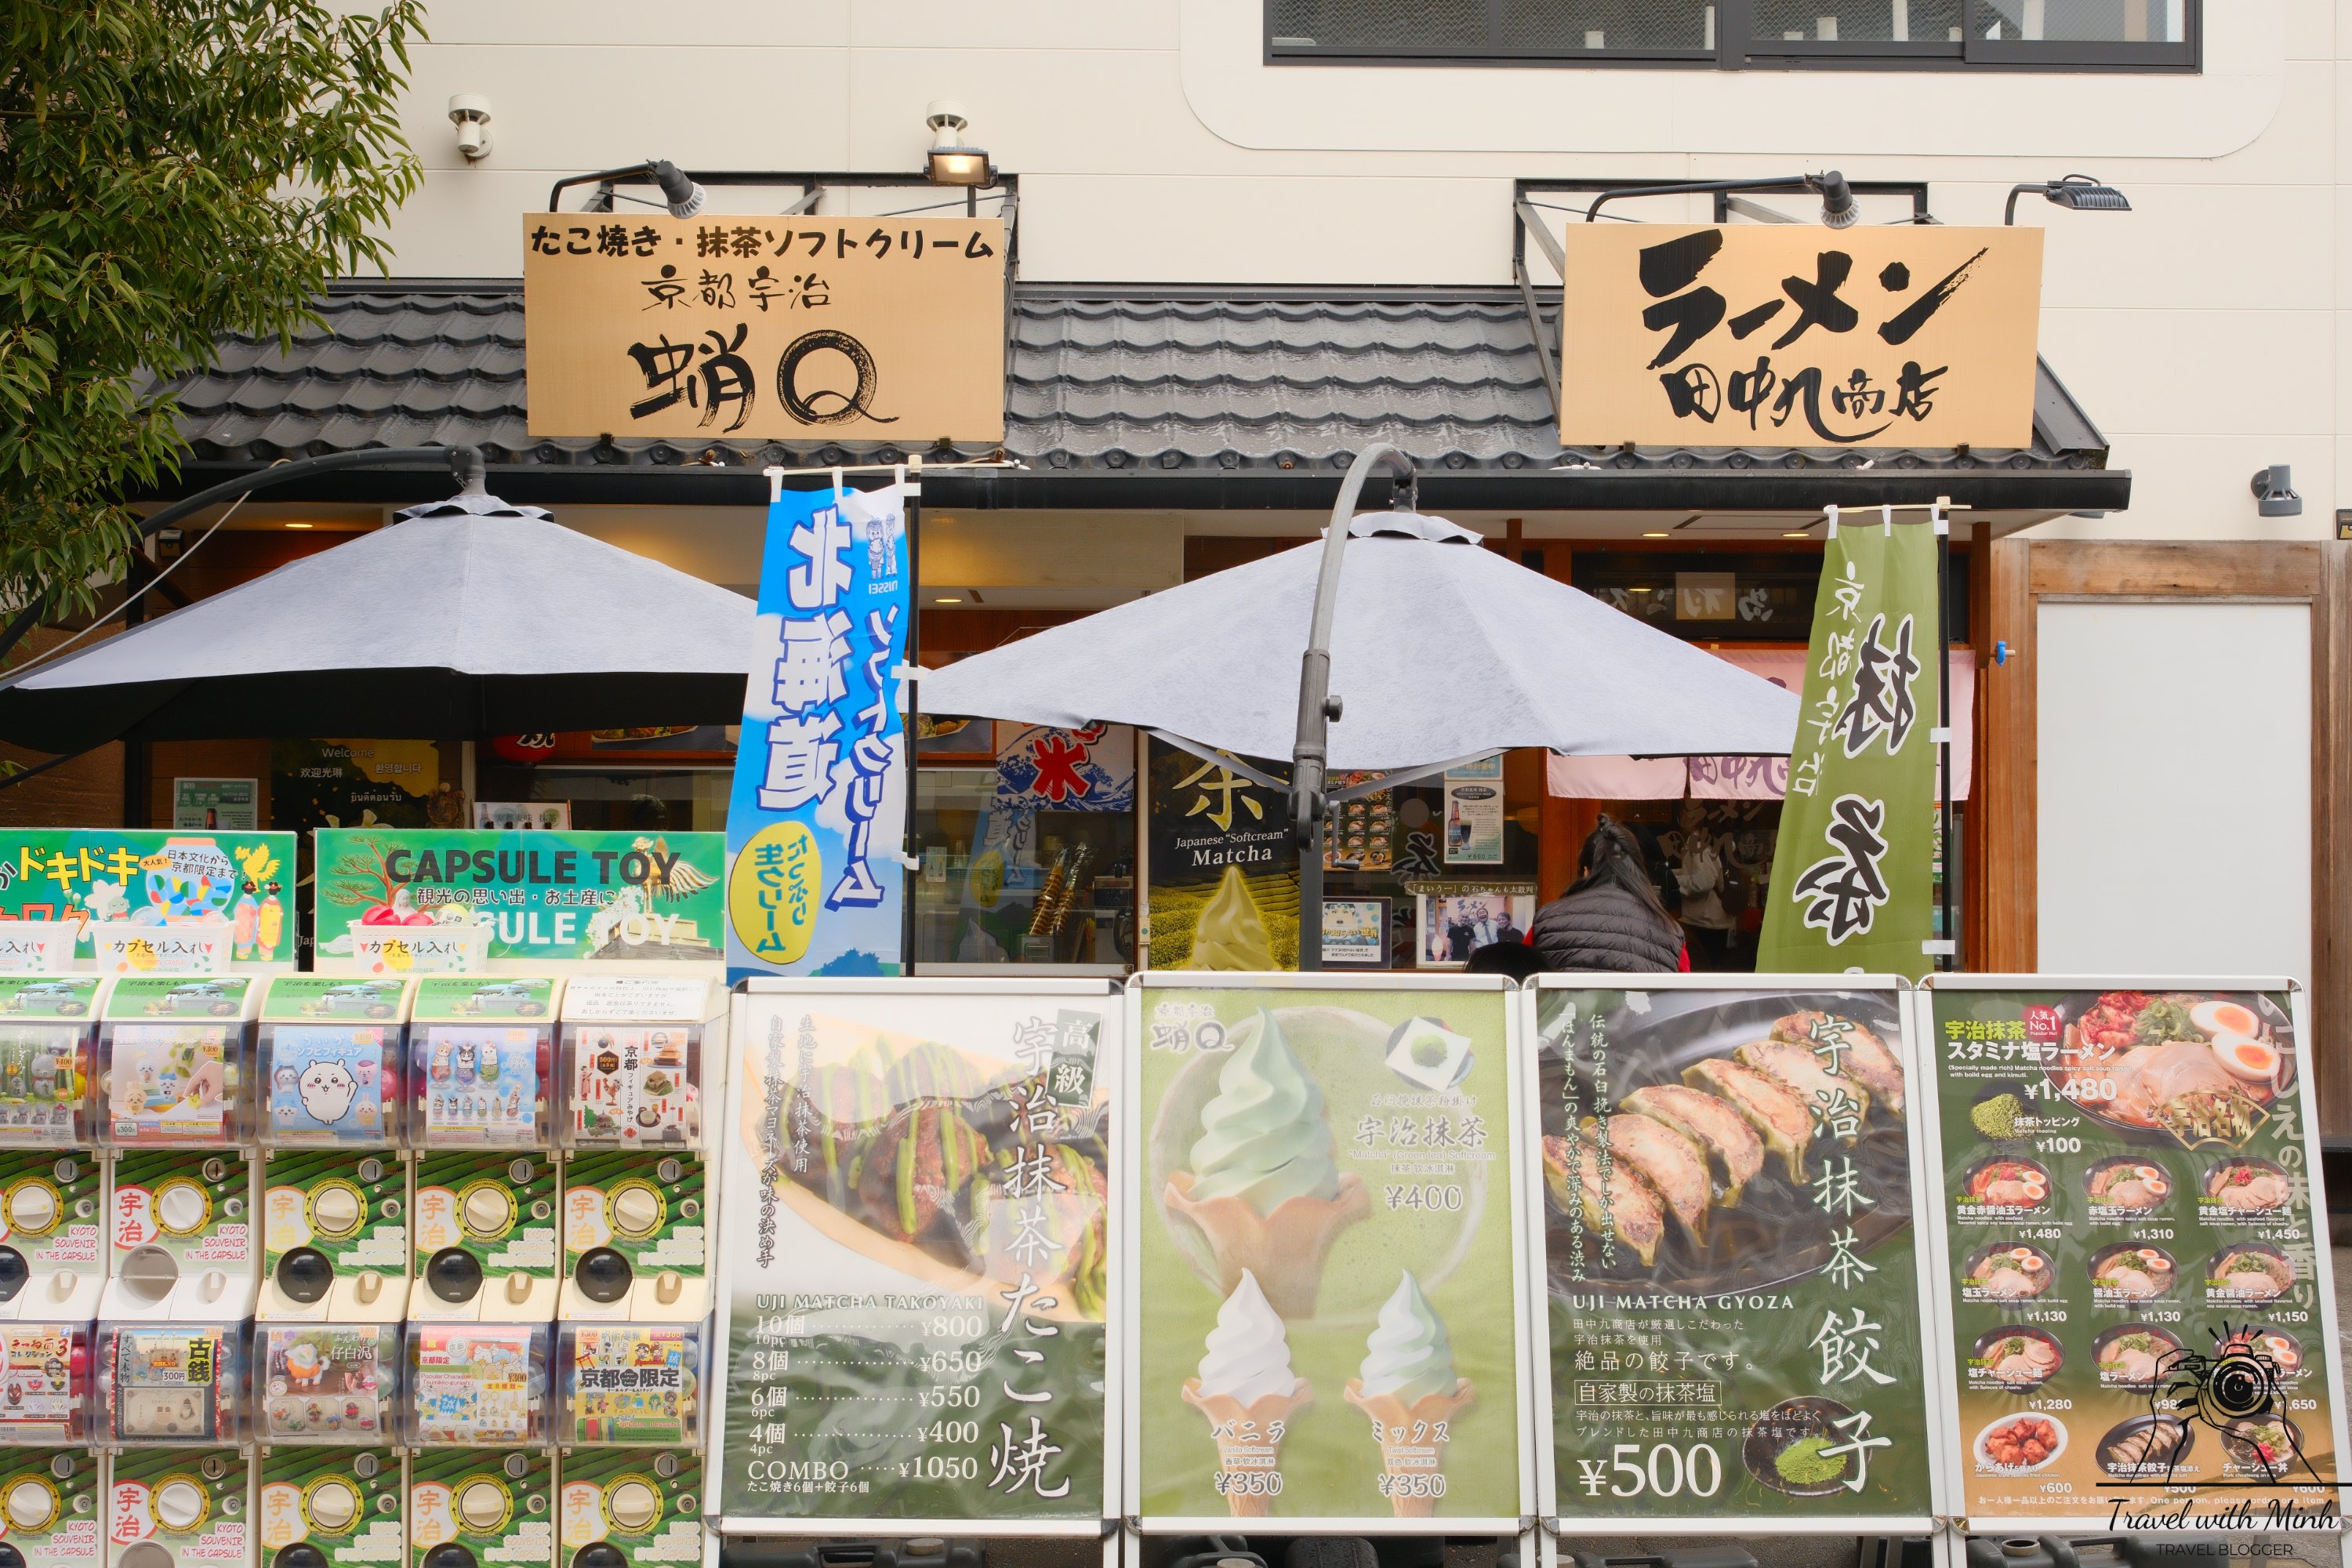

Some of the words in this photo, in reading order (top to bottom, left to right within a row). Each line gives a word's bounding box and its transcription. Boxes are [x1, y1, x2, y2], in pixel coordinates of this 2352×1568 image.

[531, 224, 995, 260] たこ焼き・抹茶ソフトクリーム
[641, 264, 832, 310] 京都宇治
[1639, 228, 1989, 370] ラーメン
[322, 747, 374, 758] Welcome
[375, 763, 422, 774] 환영합니다
[1031, 735, 1091, 804] 氷
[1175, 835, 1224, 850] Japanese
[168, 849, 229, 866] 日本文化から
[1191, 845, 1272, 867] Matcha
[20, 846, 140, 891] ドキドキ
[387, 848, 575, 884] CAPSULE
[593, 851, 681, 885] TOY
[417, 888, 615, 907] 観光の思い出・お土産に
[113, 939, 205, 954] カプセル入れ
[369, 938, 459, 954] カプセル入れ
[1157, 1003, 1214, 1018] 京都宇治
[2030, 1010, 2049, 1019] 人気
[1945, 1021, 2026, 1040] 宇治抹茶
[2030, 1017, 2056, 1031] No.1
[202, 1045, 218, 1054] ¥300
[1054, 1019, 1092, 1095] 高級
[1947, 1041, 2116, 1061] スタミナ塩ラーメン
[624, 1046, 638, 1072] 京都
[793, 1015, 817, 1174] 生地に宇治抹茶使用
[2024, 1078, 2118, 1102] ¥1,480
[2014, 1116, 2080, 1127] 抹茶トッピング
[2169, 1098, 2253, 1139] 宇治名物
[1356, 1116, 1487, 1147] 宇治抹茶
[756, 1015, 785, 1269] 自家製抹茶マヨネーズが味の決め手
[1559, 1012, 1586, 1283] 「ほんまもん」の爽やかで深みのある渋み
[1589, 1014, 1616, 1269] 伝統の石臼挽き製法でしか出せない
[2035, 1137, 2082, 1153] ¥100
[1348, 1149, 1391, 1160] "Matcha"
[1393, 1149, 1424, 1161] (Green
[1426, 1149, 1446, 1161] tea)
[1448, 1150, 1496, 1160] Softcream
[1385, 1185, 1462, 1211] ¥400
[118, 1192, 144, 1243] 宇治
[1957, 1205, 2051, 1216] 黄金赤醤油玉ラーメン
[2088, 1205, 2153, 1216] 赤塩玉ラーメン
[269, 1194, 296, 1249] 宇治
[70, 1225, 96, 1236] KYOTO
[219, 1225, 246, 1236] KYOTO
[2019, 1229, 2061, 1240] ¥1,480
[2133, 1229, 2174, 1240] ¥1,310
[2258, 1229, 2300, 1240] ¥1,450
[55, 1238, 96, 1248] SOUVENIR
[204, 1237, 246, 1248] SOUVENIR
[35, 1250, 44, 1260] IN
[45, 1250, 60, 1260] THE
[61, 1250, 96, 1261] CAPSULE
[988, 1017, 1071, 1497] 宇治抹茶たこ焼
[1807, 1014, 1896, 1494] 宇治抹茶餃子
[1962, 1287, 2016, 1298] 塩玉ラーメン
[2092, 1287, 2158, 1298] 醤油玉ラーメン
[2205, 1288, 2281, 1298] 黄金醤油ラーメン
[756, 1294, 785, 1310] UJI
[793, 1294, 877, 1310] MATCHA
[885, 1295, 984, 1311] TAKOYAKI
[1573, 1295, 1605, 1311] UJI
[1616, 1295, 1708, 1310] MATCHA
[1719, 1295, 1795, 1310] GYOZA
[1573, 1318, 1744, 1330] 田中九商店が厳選しこだわった
[2027, 1311, 2067, 1323] ¥1,130
[2140, 1311, 2181, 1323] ¥1,130
[2268, 1311, 2308, 1323] ¥1,150
[755, 1315, 805, 1336] 10個
[921, 1315, 982, 1338] ¥800
[56, 1338, 69, 1357] 3
[755, 1336, 786, 1347] 10pc
[1574, 1334, 1661, 1347] 宇治抹茶を使用
[120, 1335, 133, 1383] すべて本物
[188, 1338, 212, 1383] 古銭
[752, 1350, 789, 1372] 8個
[920, 1351, 982, 1373] ¥650
[1574, 1350, 1755, 1372] 絶品の餃子です。
[163, 1372, 185, 1381] 300円
[508, 1373, 527, 1382] ¥300
[580, 1368, 620, 1388] 京都
[640, 1368, 680, 1388] 限定
[752, 1372, 776, 1383] 8pc
[2100, 1370, 2146, 1382] 塩ラーメン
[750, 1387, 787, 1407] 6個
[919, 1385, 980, 1408] ¥550
[1579, 1383, 1715, 1403] 自家製の抹茶塩
[751, 1407, 775, 1418] 6pc
[2029, 1399, 2072, 1410] ¥1,280
[749, 1423, 786, 1444] 4個
[917, 1421, 978, 1444] ¥400
[1211, 1420, 1286, 1443] バニラ
[1372, 1421, 1450, 1443] ミックス
[1576, 1425, 1821, 1439] ブレンドした田中九商店の抹茶塩です。
[750, 1444, 773, 1455] 4pc
[1244, 1446, 1274, 1454] Softcream
[1405, 1446, 1435, 1455] Softcream
[747, 1461, 849, 1481] COMBO
[898, 1457, 978, 1479] ¥1050
[1577, 1443, 1722, 1497] ¥500
[1215, 1472, 1283, 1495] ¥350
[1378, 1474, 1446, 1497] ¥350
[2039, 1483, 2073, 1494] ¥600
[2215, 1497, 2247, 1506] please
